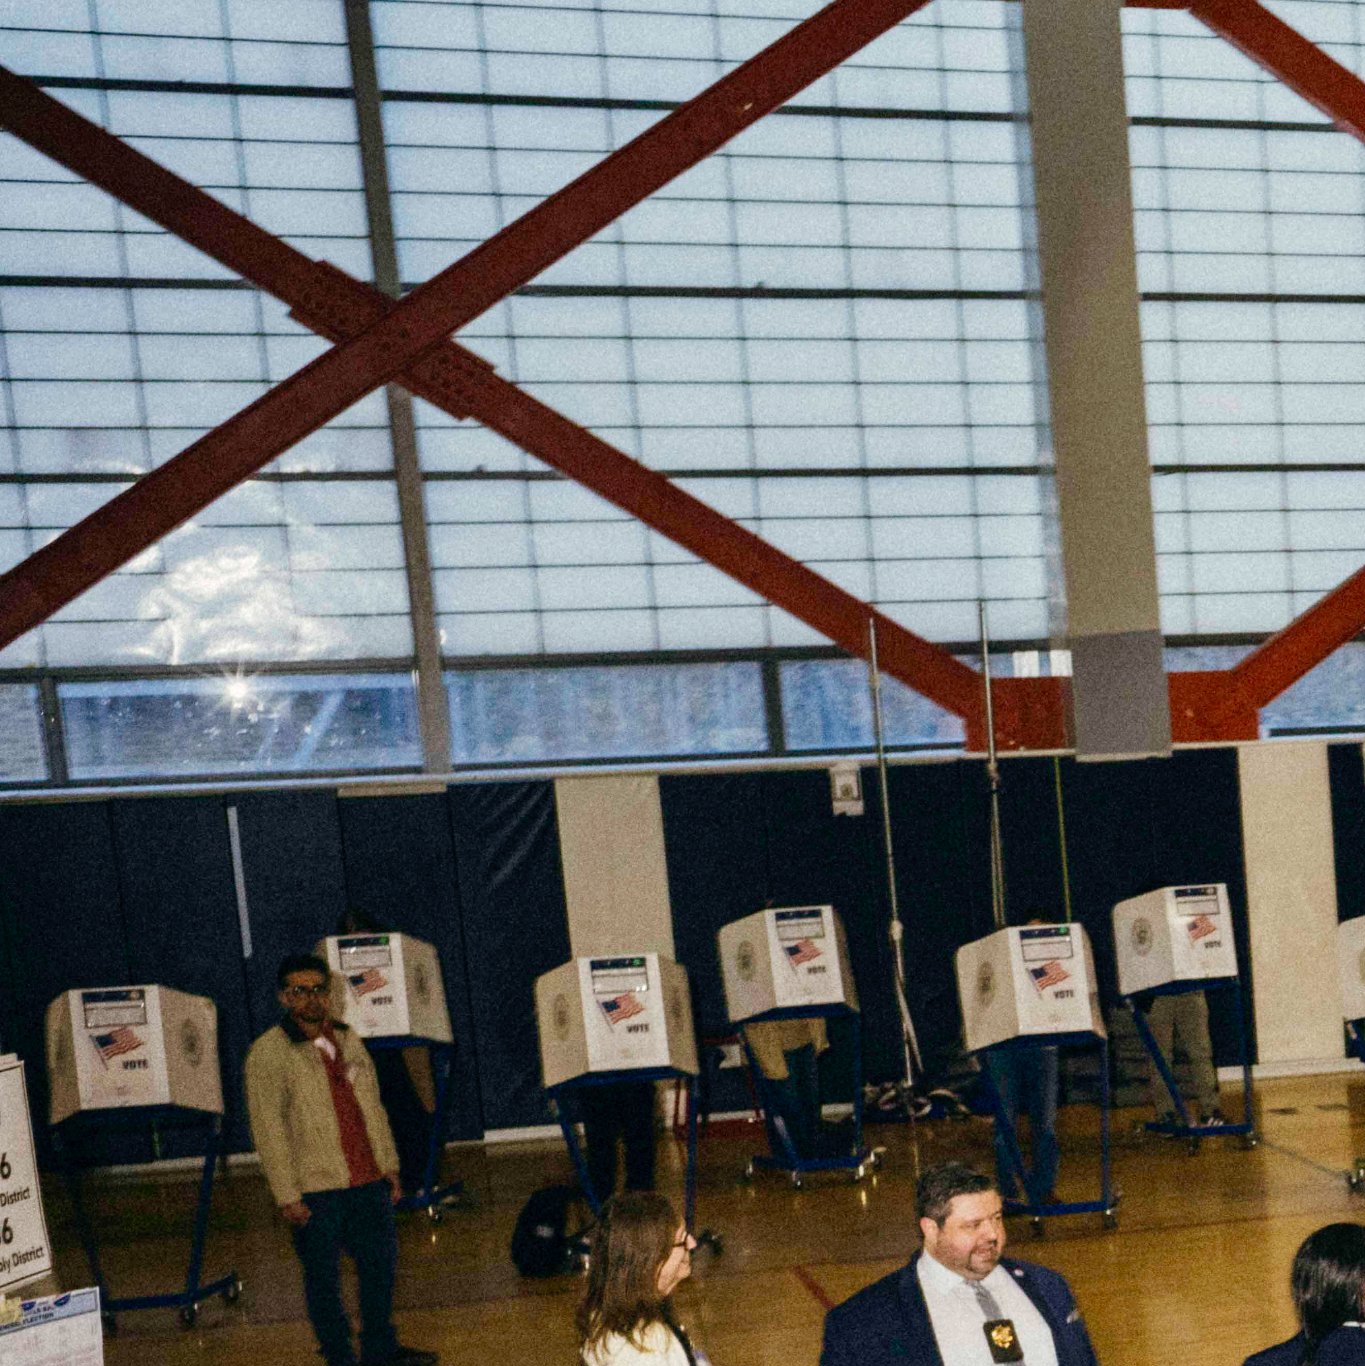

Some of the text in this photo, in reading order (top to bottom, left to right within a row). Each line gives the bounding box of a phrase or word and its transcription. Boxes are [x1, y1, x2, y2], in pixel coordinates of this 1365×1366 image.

[806, 965, 827, 975] VOTE
[1053, 989, 1074, 999] VOTE
[371, 995, 392, 1005] VOTE
[626, 1023, 649, 1033] VOTE
[122, 1059, 148, 1070] VOTE
[0, 1217, 14, 1245] 6
[12, 1246, 44, 1267] District
